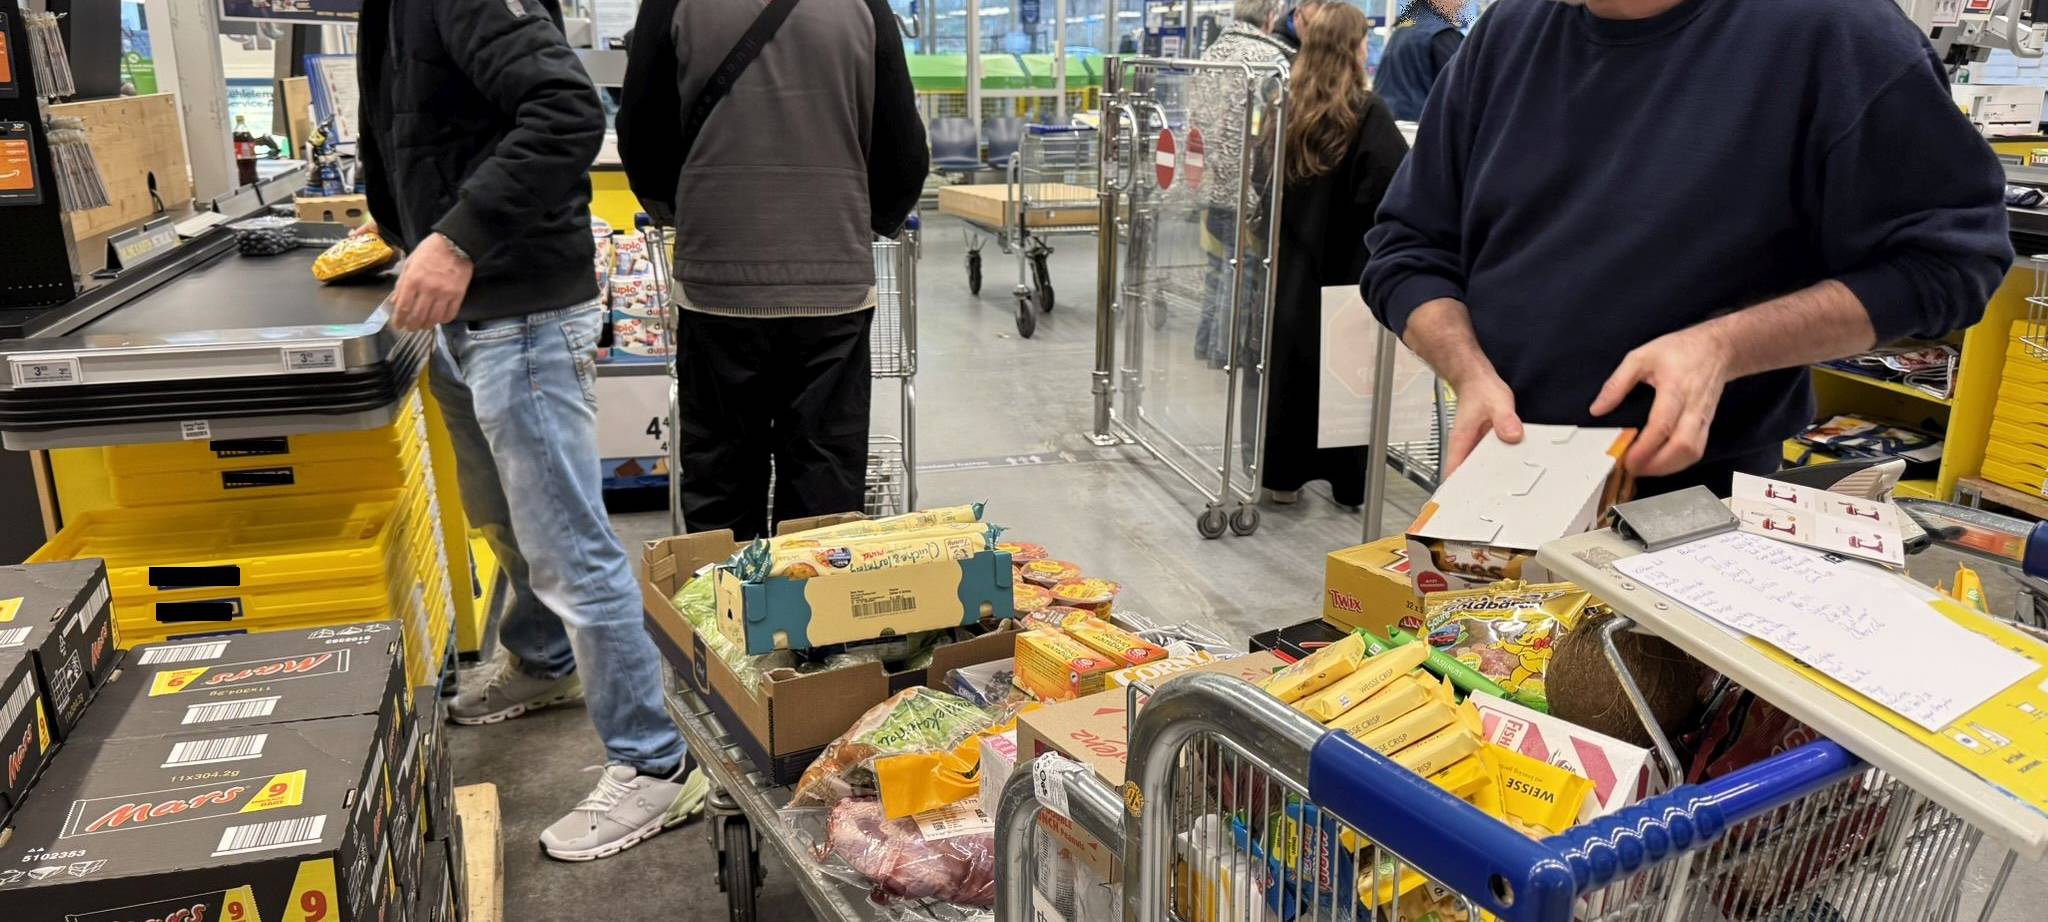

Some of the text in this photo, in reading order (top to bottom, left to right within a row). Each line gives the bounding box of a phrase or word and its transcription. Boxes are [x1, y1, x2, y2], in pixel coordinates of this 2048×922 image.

[1329, 588, 1363, 613] Twix
[90, 620, 108, 672] Mars
[205, 652, 332, 685] Mars
[1361, 715, 1381, 730] CRISP
[1388, 733, 1408, 750] CRISP
[8, 722, 33, 788] Mars
[170, 769, 241, 783] 11x304.2g
[269, 782, 287, 798] 9
[1505, 777, 1554, 804] WEISSE
[84, 786, 245, 832] Mars
[22, 849, 87, 863] 5102353
[300, 889, 328, 922] 9
